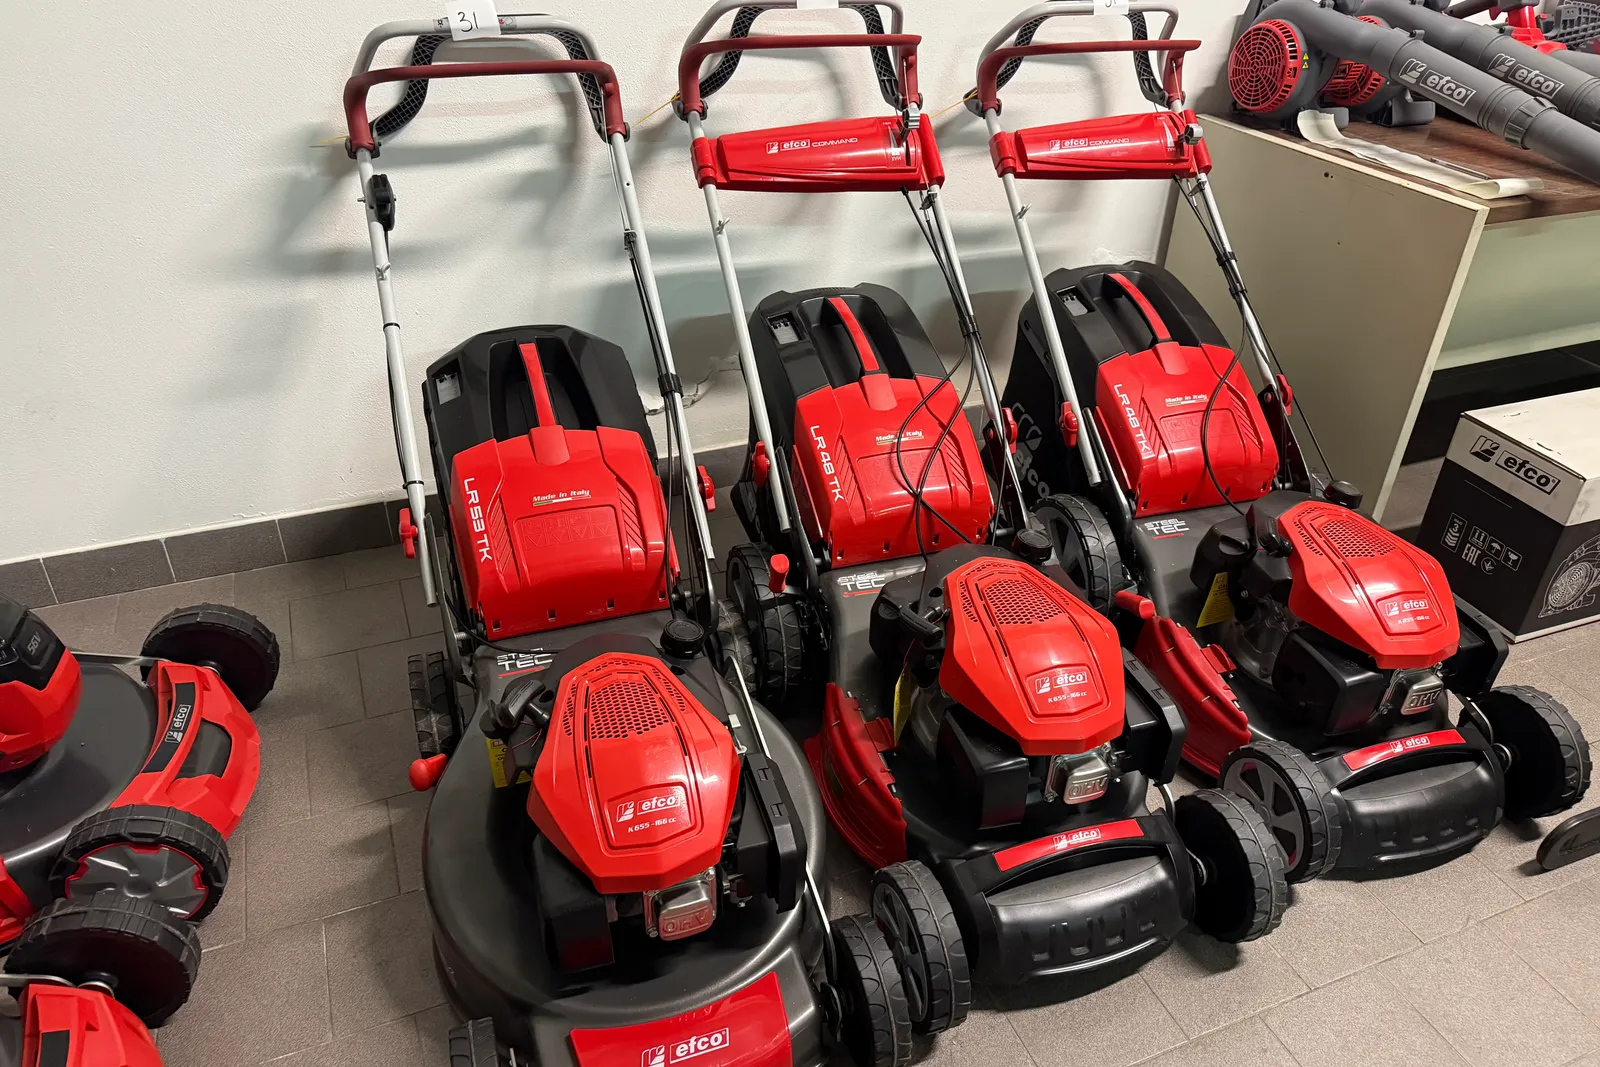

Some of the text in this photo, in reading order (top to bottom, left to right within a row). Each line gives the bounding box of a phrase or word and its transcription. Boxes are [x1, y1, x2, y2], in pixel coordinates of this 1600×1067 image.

[457, 11, 479, 32] 31
[1426, 75, 1467, 100] efco
[1514, 68, 1555, 93] efco
[783, 138, 858, 149] efco COMMAND
[1064, 138, 1130, 147] efco COMMAND
[875, 434, 896, 442] Made
[1135, 429, 1151, 452] TK
[810, 425, 827, 450] LR
[829, 475, 845, 502] TK
[1503, 456, 1550, 488] efco
[532, 493, 556, 502] Made
[570, 489, 590, 497] Italy
[464, 477, 480, 505] LR
[477, 533, 493, 563] TK
[1144, 518, 1186, 528] STEEL
[1452, 523, 1460, 532] 3
[1147, 522, 1190, 535] TEC
[837, 571, 884, 584] STEEL
[840, 577, 885, 591] TEC
[1403, 600, 1425, 609] efco
[497, 653, 553, 671] TEC
[1056, 673, 1083, 685] efco
[1407, 690, 1440, 710] OHV
[173, 707, 188, 728] efco
[1406, 737, 1427, 746] efco
[1068, 777, 1108, 798] OHV
[641, 796, 676, 811] efco
[1072, 830, 1098, 841] efco
[663, 909, 709, 933] OHV
[675, 1033, 723, 1057] efco
